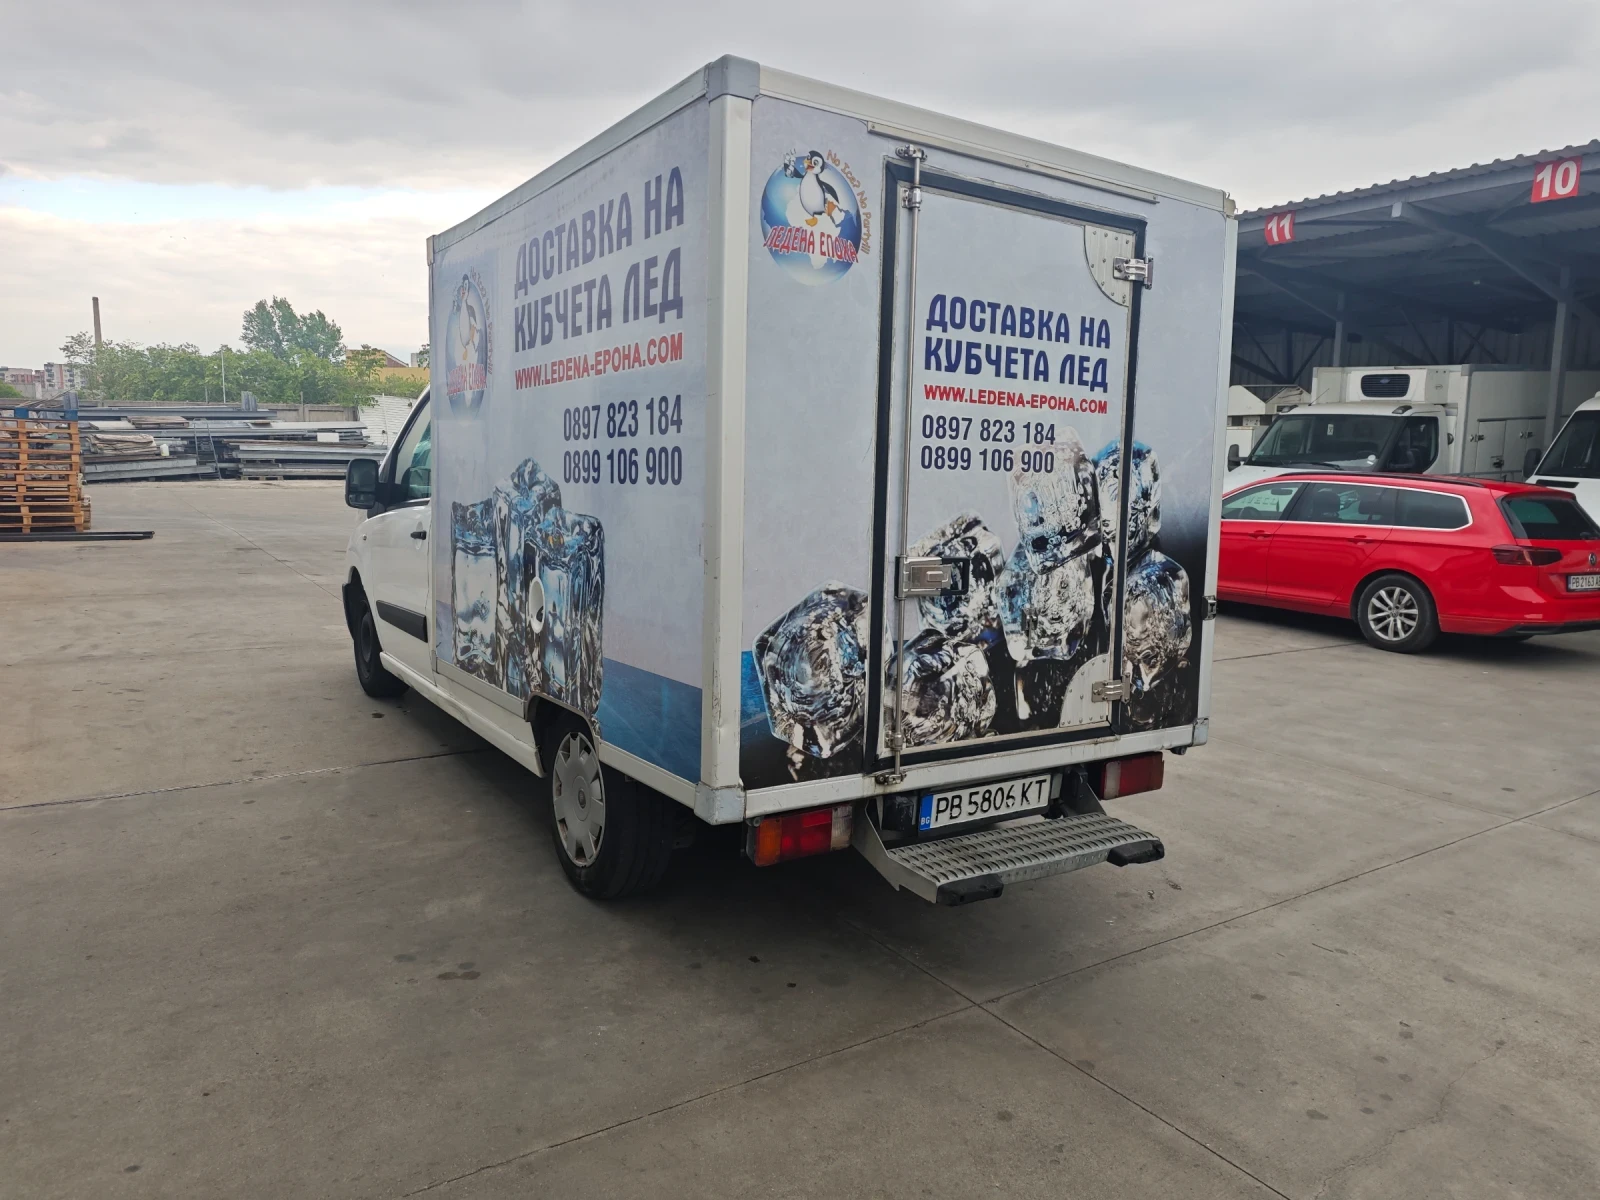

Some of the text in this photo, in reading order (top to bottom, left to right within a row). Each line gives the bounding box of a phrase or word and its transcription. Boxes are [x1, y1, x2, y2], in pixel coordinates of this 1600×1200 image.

[826, 149, 842, 167] No
[840, 162, 862, 189] Ice?
[857, 189, 868, 210] No
[1535, 160, 1579, 199] 10
[514, 165, 684, 299] ДОСТАВКА НА
[762, 225, 816, 255] ЛЕДЕНА
[1267, 213, 1292, 242] 11
[514, 273, 612, 353] КУБЧЕТА
[622, 246, 684, 324] ЛЕД
[926, 293, 1111, 350] ДОСТАВКА НА
[514, 333, 683, 389] WWW.LEDENA-EPOHA.COM
[924, 336, 1108, 394] КУБЧЕТА ЛЕД
[563, 394, 683, 442] 0897 823 184
[923, 384, 1108, 414] WWW.LEDENA-EPOHA.COM
[921, 414, 1056, 446] 0897 823 184
[563, 445, 683, 485] 0899 106 900
[920, 445, 1055, 474] 0899 106 900
[920, 817, 931, 826] BG
